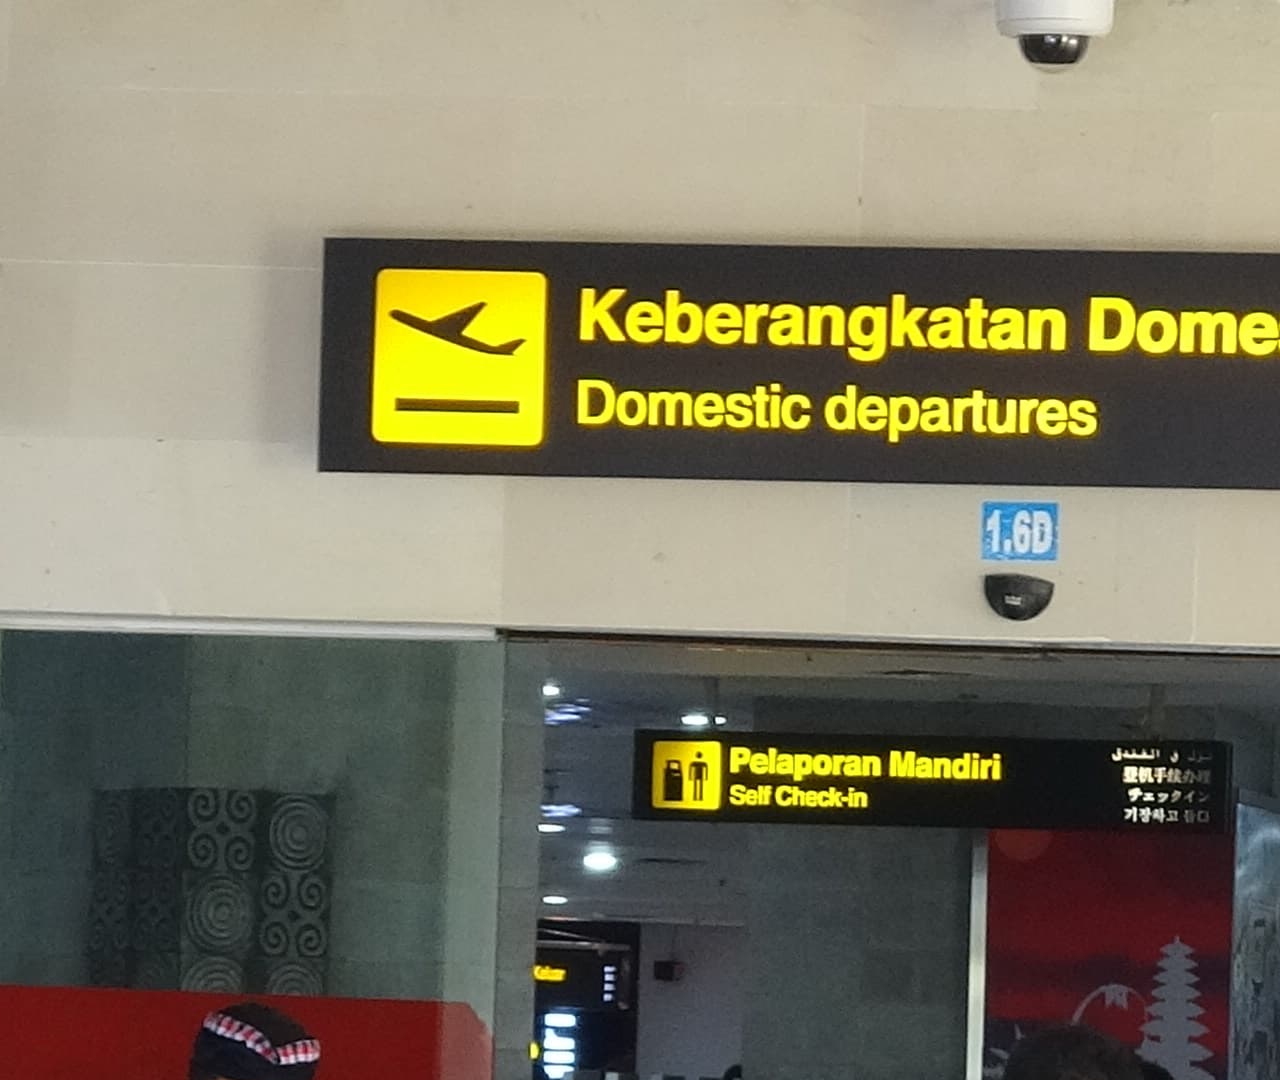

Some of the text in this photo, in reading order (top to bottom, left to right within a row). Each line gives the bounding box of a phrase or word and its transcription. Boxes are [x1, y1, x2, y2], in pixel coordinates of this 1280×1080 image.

[578, 287, 1067, 362] Keberangkatan
[576, 378, 1098, 443] Domestic departures
[986, 509, 1053, 554] 1.6D
[729, 746, 1002, 781] Pelaporan Mandiri
[729, 785, 869, 808] Self Check-in
[1127, 786, 1210, 803] チェックイン
